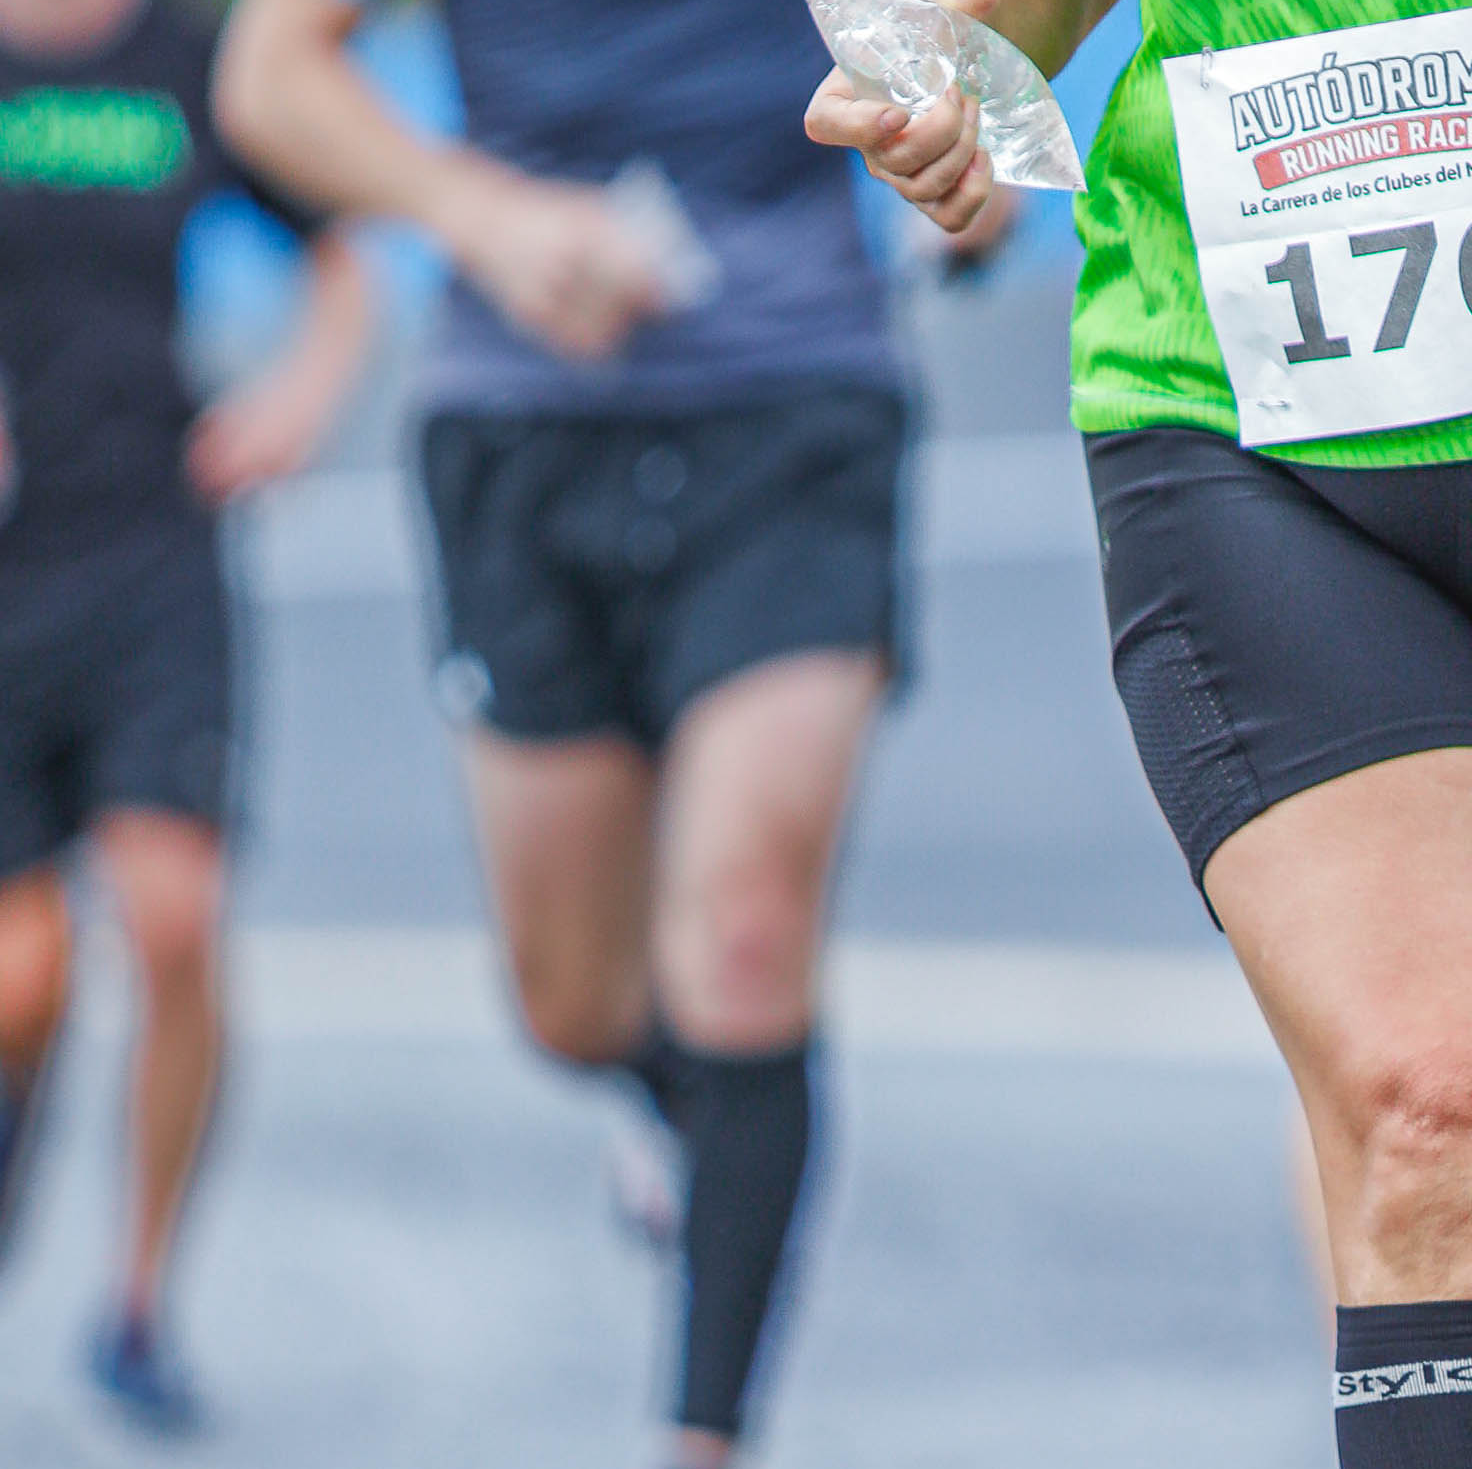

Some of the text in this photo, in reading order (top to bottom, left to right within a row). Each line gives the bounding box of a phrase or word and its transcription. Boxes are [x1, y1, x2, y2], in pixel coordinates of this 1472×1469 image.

[1278, 123, 1400, 181] RUNNING
[1240, 200, 1259, 217] La
[1261, 191, 1319, 214] Carrera
[1322, 185, 1343, 204] de
[1346, 181, 1371, 198] los
[1374, 172, 1432, 193] Clubes
[1436, 165, 1463, 185] del
